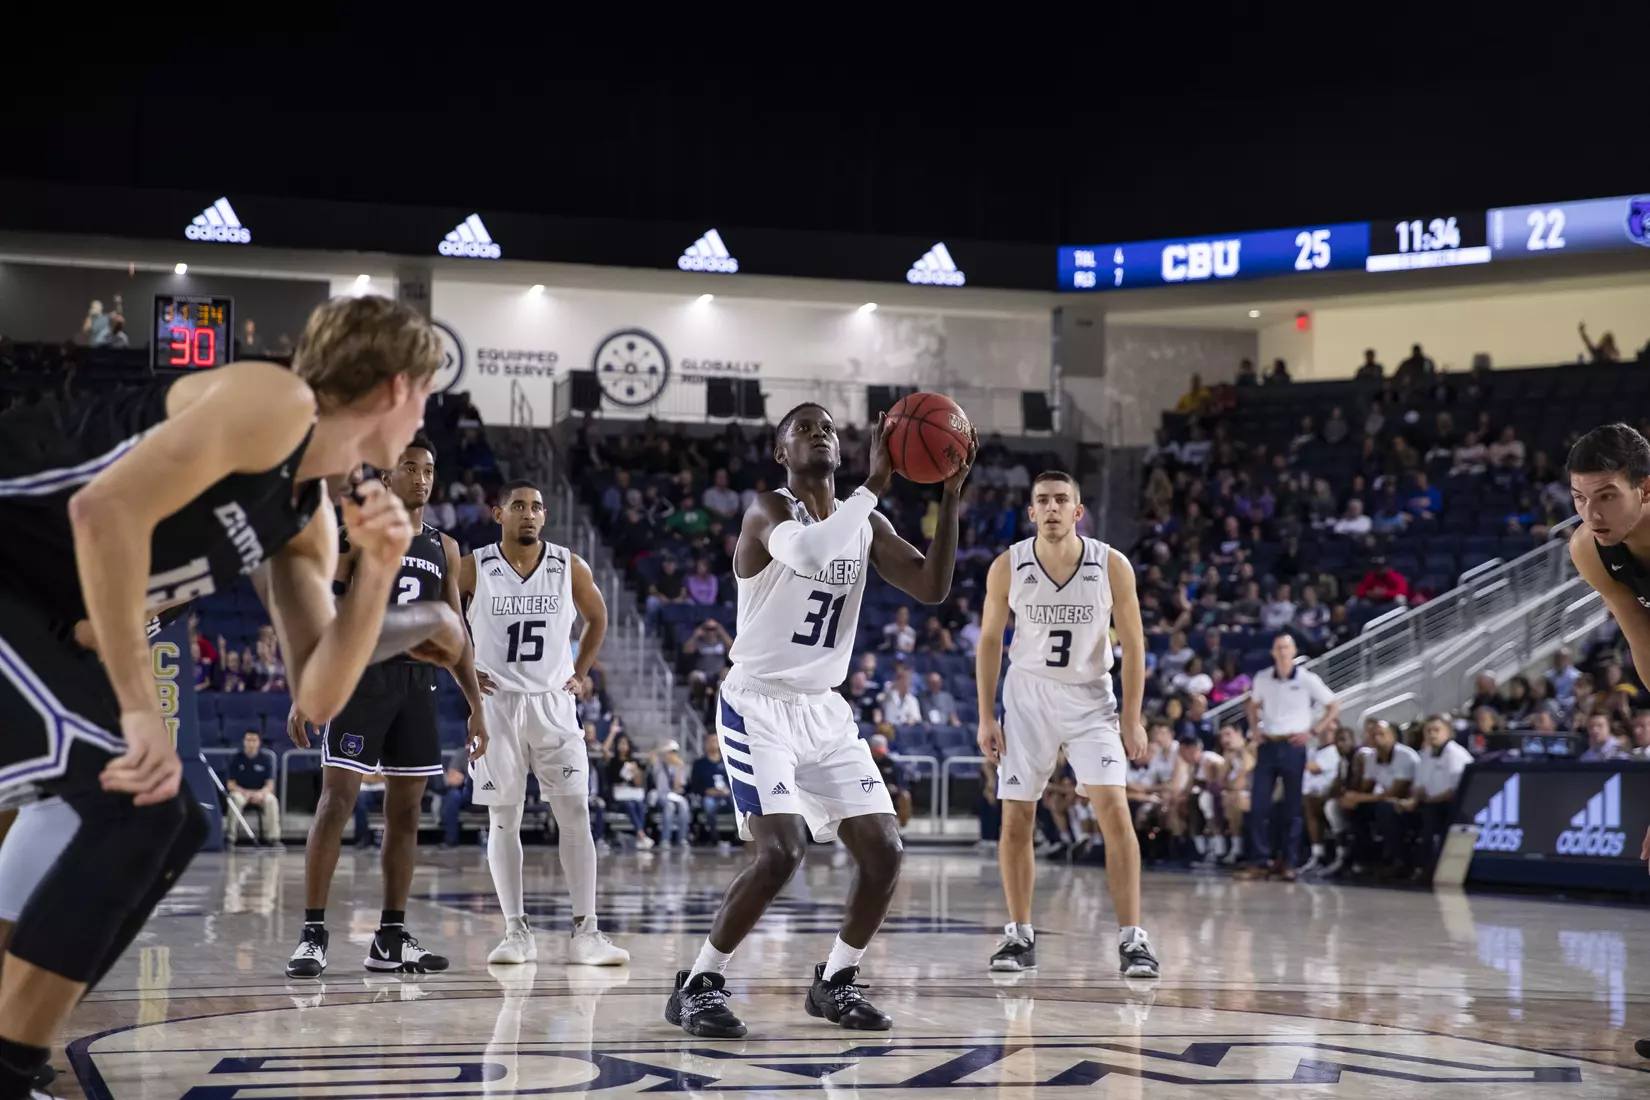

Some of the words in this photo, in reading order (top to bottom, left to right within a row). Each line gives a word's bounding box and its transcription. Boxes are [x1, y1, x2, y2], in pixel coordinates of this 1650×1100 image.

[184, 223, 252, 243] adidas
[1396, 217, 1460, 252] 11:34
[1526, 208, 1566, 251] 22
[438, 239, 501, 259] adidas
[677, 254, 739, 274] adidas
[1161, 239, 1241, 282] CBU
[1295, 229, 1331, 270] 25
[170, 327, 215, 366] 30
[477, 349, 558, 361] EQUIPPED
[478, 363, 499, 374] TO
[504, 365, 555, 377] SERVE
[681, 360, 761, 373] GLOBALLY
[398, 576, 421, 606] 2
[492, 595, 559, 615] LANCERS
[791, 590, 847, 648] 31
[1025, 604, 1094, 624] LANCERS
[506, 620, 546, 662] 15
[1046, 629, 1072, 668] 3
[1474, 822, 1524, 852] didas
[1556, 824, 1626, 857] adidas
